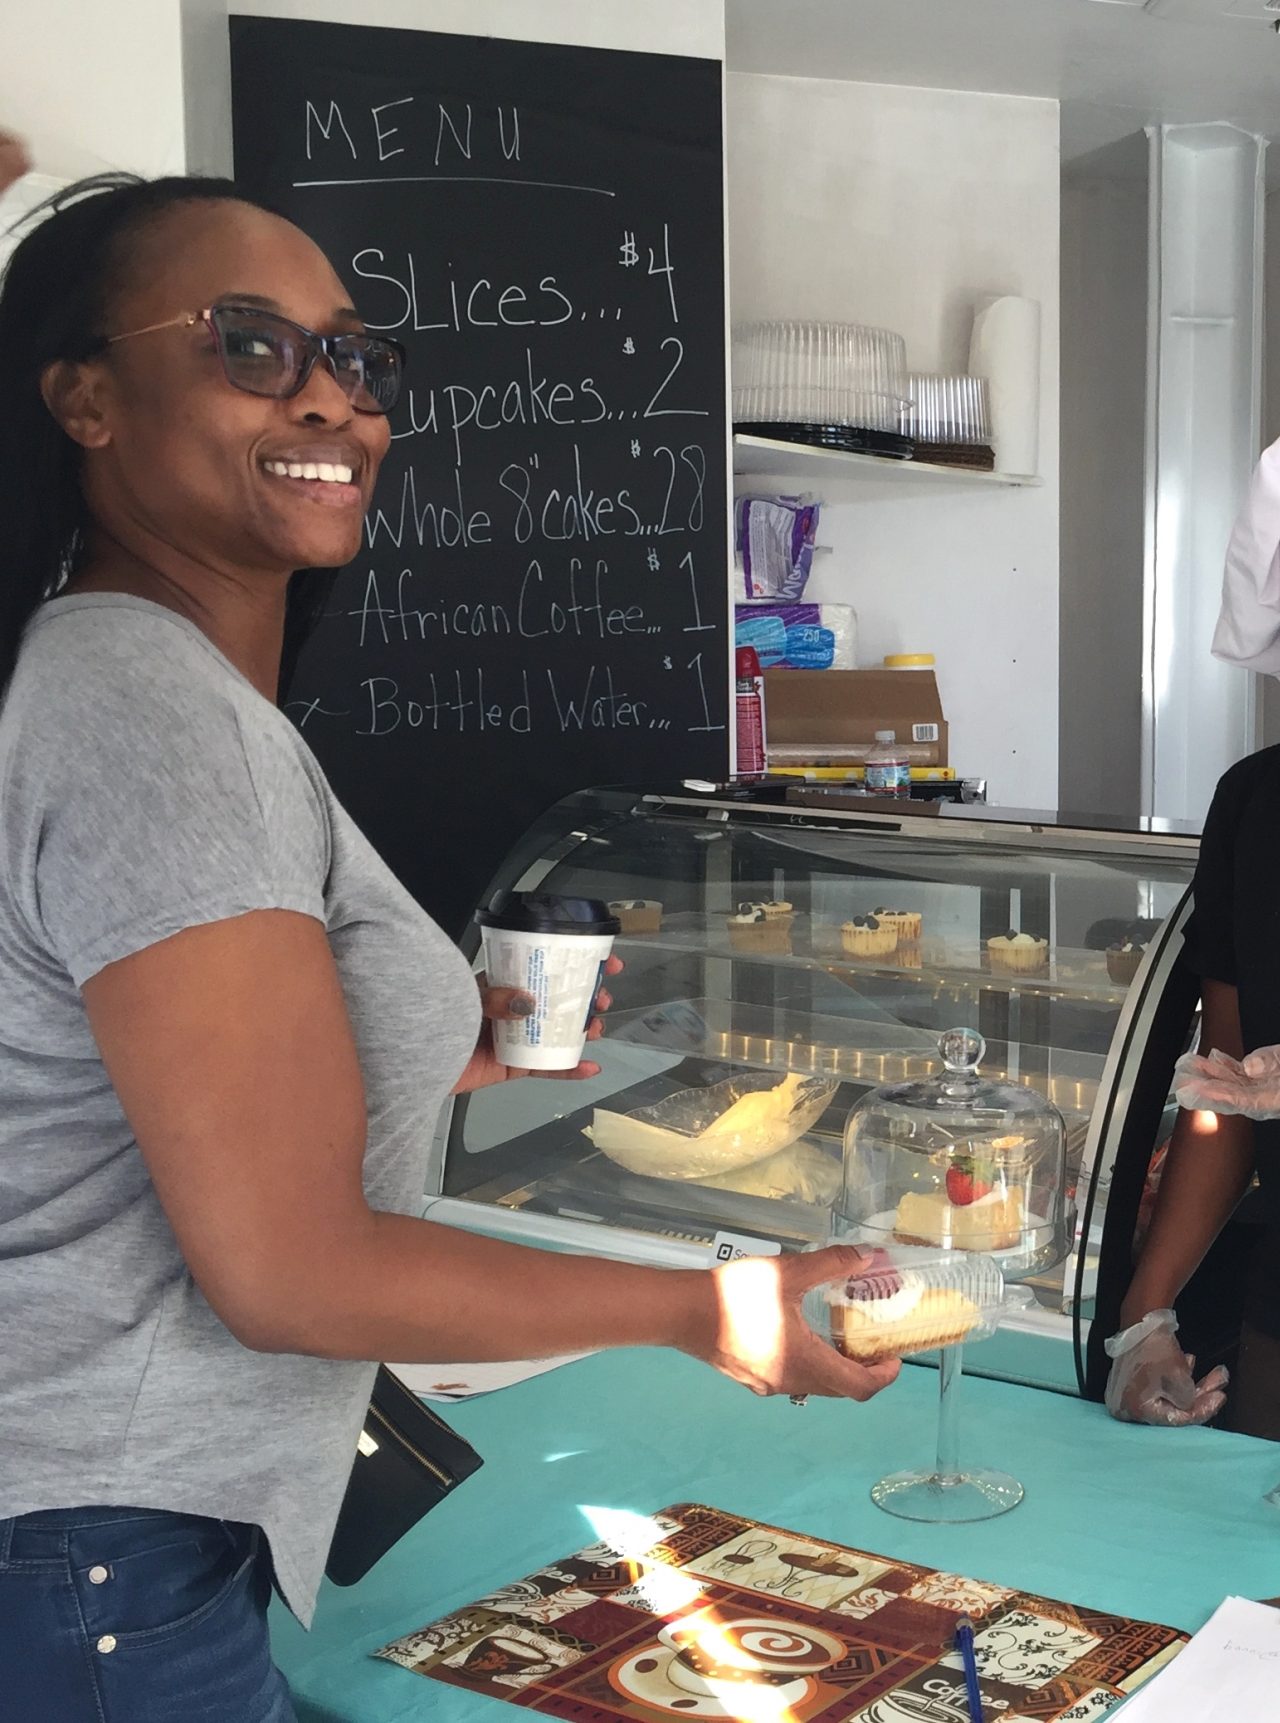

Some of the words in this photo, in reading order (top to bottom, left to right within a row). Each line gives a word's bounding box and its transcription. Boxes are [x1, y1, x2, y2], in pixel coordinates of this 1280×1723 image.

[306, 97, 521, 166] MENU
[618, 223, 679, 323] $4
[621, 337, 709, 420] $2
[348, 569, 511, 646] African
[647, 547, 717, 632] $1
[355, 666, 532, 736] Bottled
[662, 652, 726, 733] $1
